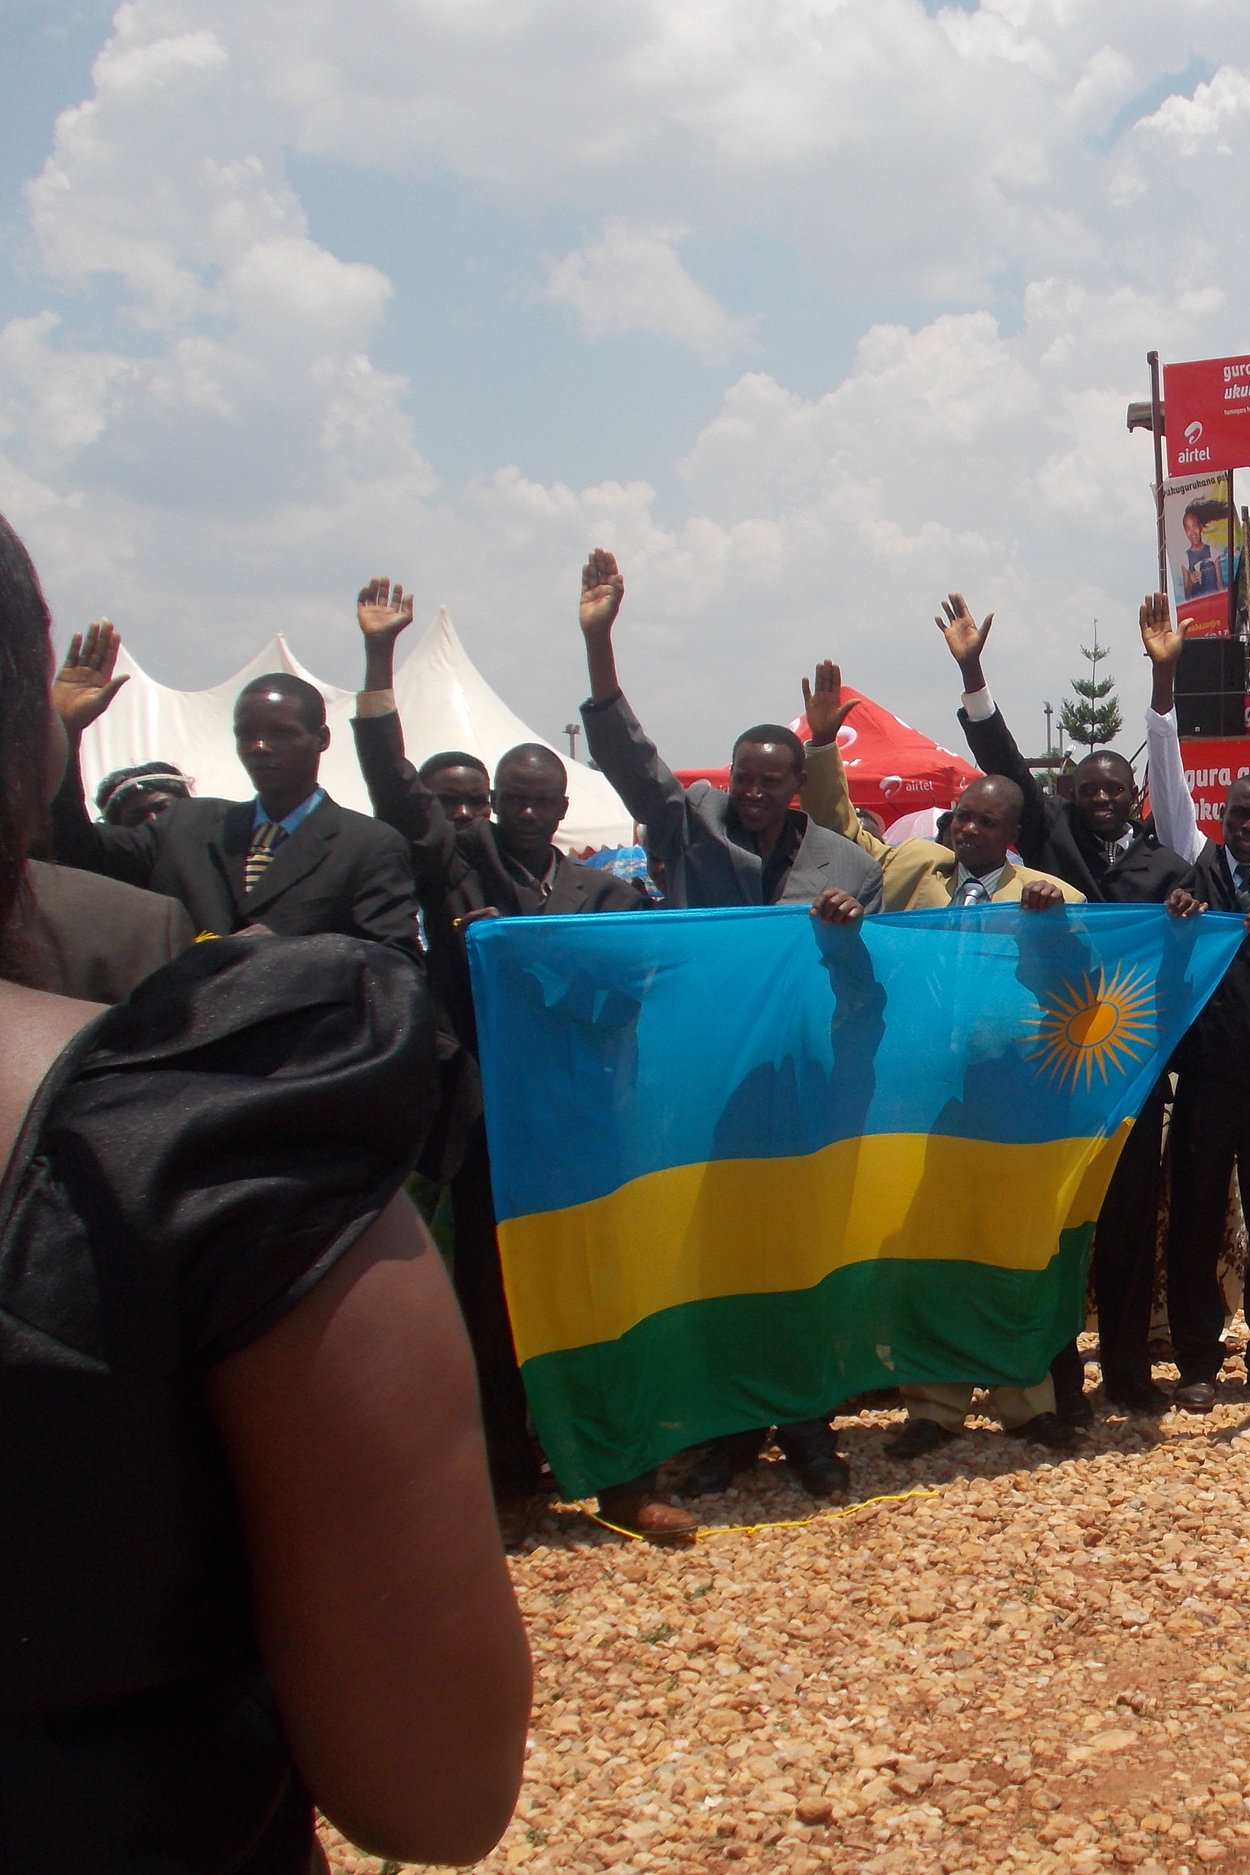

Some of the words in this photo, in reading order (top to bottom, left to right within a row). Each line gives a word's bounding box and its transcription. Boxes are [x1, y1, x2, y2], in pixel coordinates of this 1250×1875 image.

[1178, 446, 1211, 463] airtel
[905, 780, 934, 792] airtel
[1184, 767, 1232, 793] gura
